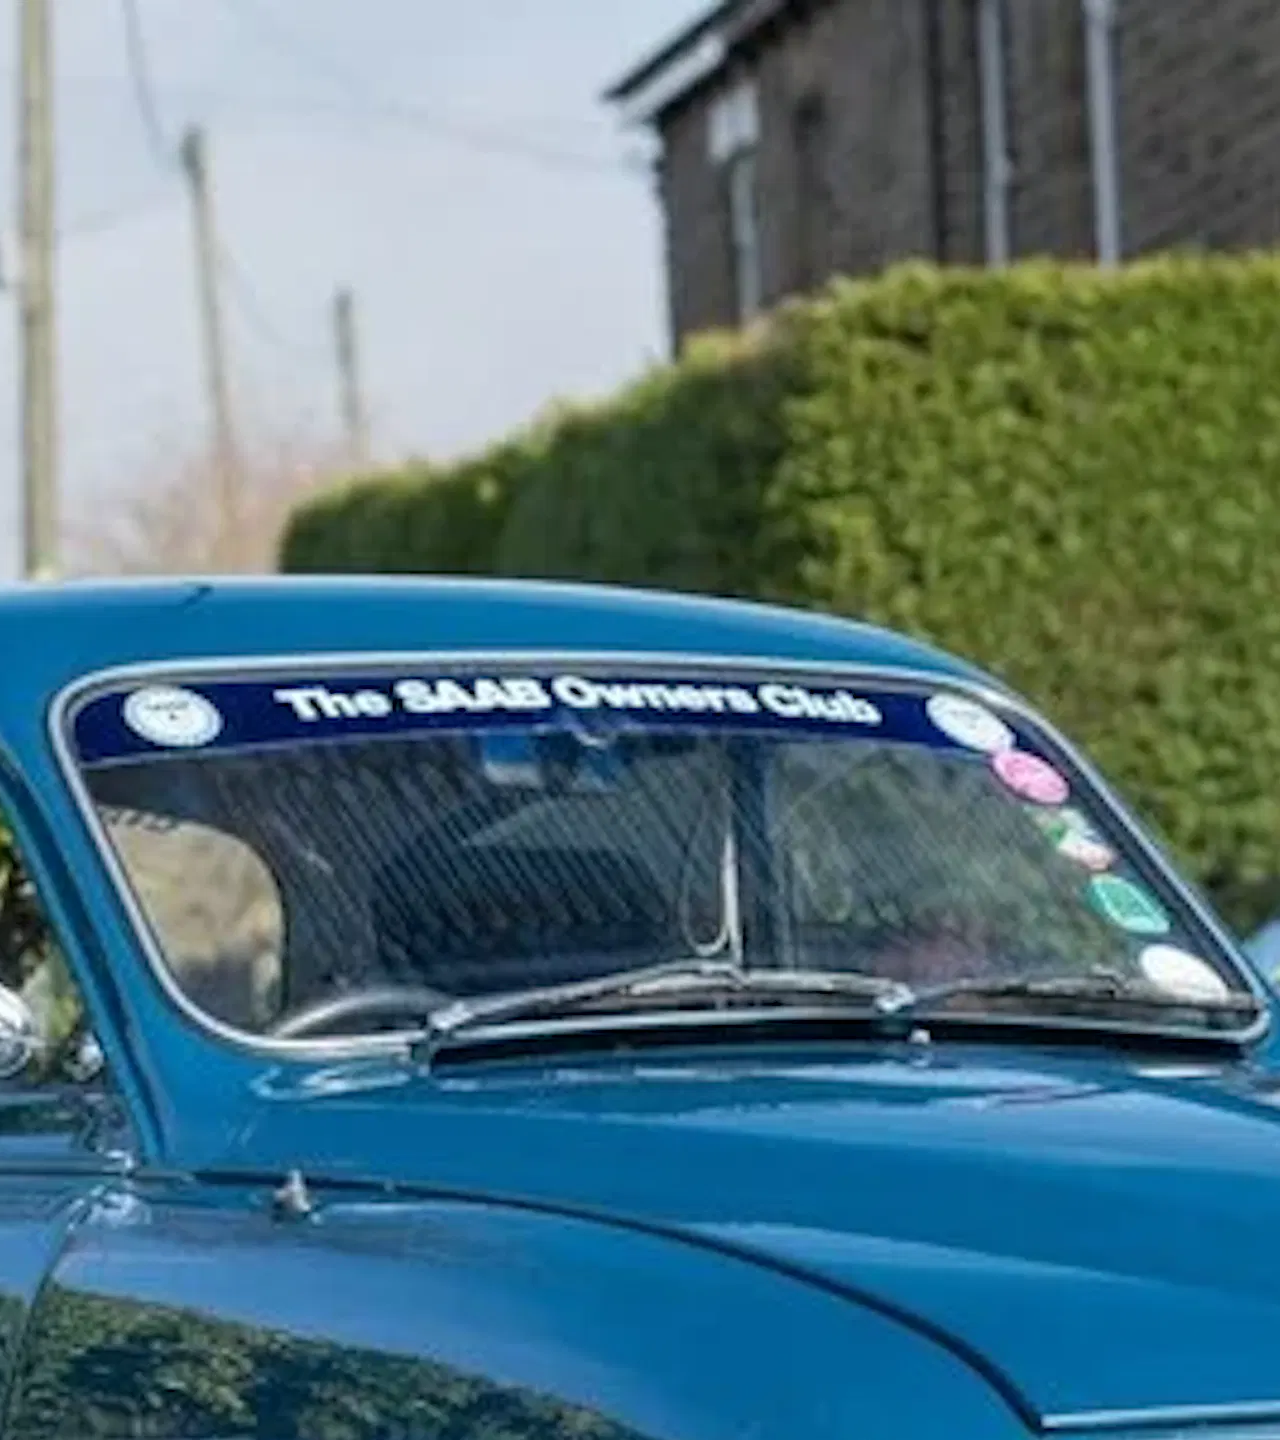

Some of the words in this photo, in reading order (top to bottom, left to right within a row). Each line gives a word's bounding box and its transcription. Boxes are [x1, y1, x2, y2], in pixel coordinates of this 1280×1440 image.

[273, 684, 393, 722] The
[393, 678, 551, 714] SAAB
[551, 674, 759, 713] Owners
[757, 683, 882, 725] Club
